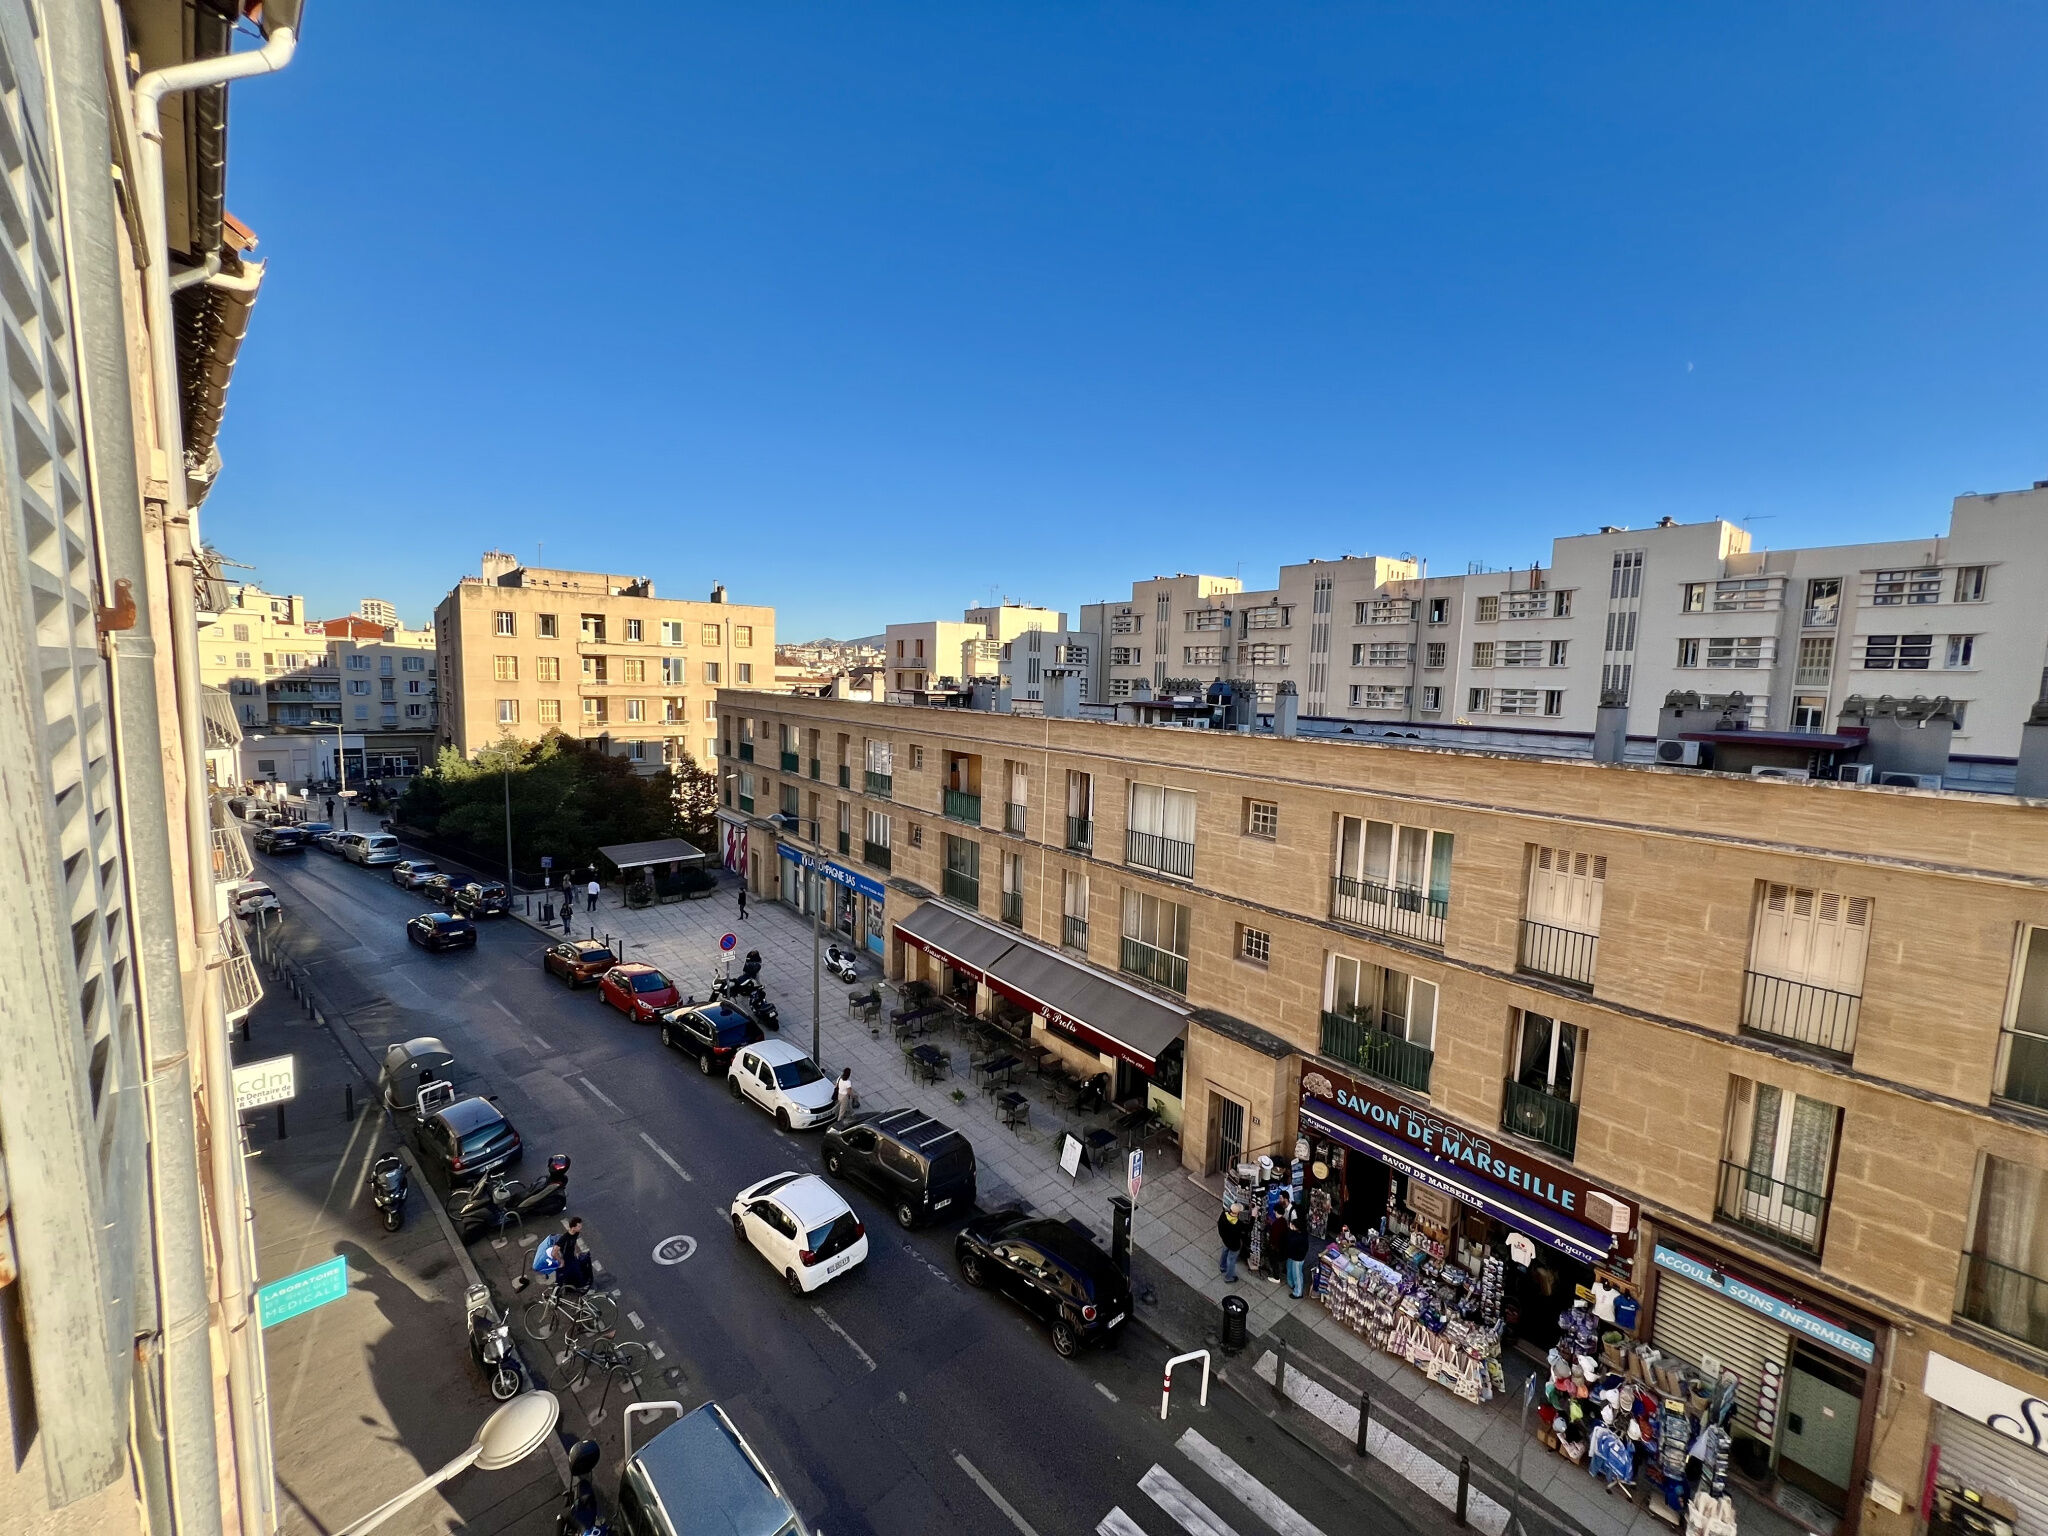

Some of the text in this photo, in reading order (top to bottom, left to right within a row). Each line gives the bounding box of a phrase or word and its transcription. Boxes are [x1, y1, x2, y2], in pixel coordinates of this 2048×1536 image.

[1040, 1006, 1051, 1018] Le
[246, 1087, 280, 1101] Dentaire
[281, 1084, 291, 1093] de
[1398, 1105, 1491, 1155] ARGANA
[1336, 1089, 1400, 1130] SAVON
[1407, 1120, 1434, 1146] DE
[1441, 1136, 1576, 1211] MARSEILLE
[1382, 1153, 1412, 1175] SAVON
[1413, 1168, 1426, 1181] DE
[1428, 1176, 1484, 1209] MARSEILLE
[1554, 1238, 1592, 1261] Argana
[264, 1267, 339, 1302] LABORATOIRE
[265, 1282, 340, 1319] MEDICALE
[1728, 1284, 1774, 1312] SOINS
[1778, 1307, 1873, 1359] INFIRMIERS
